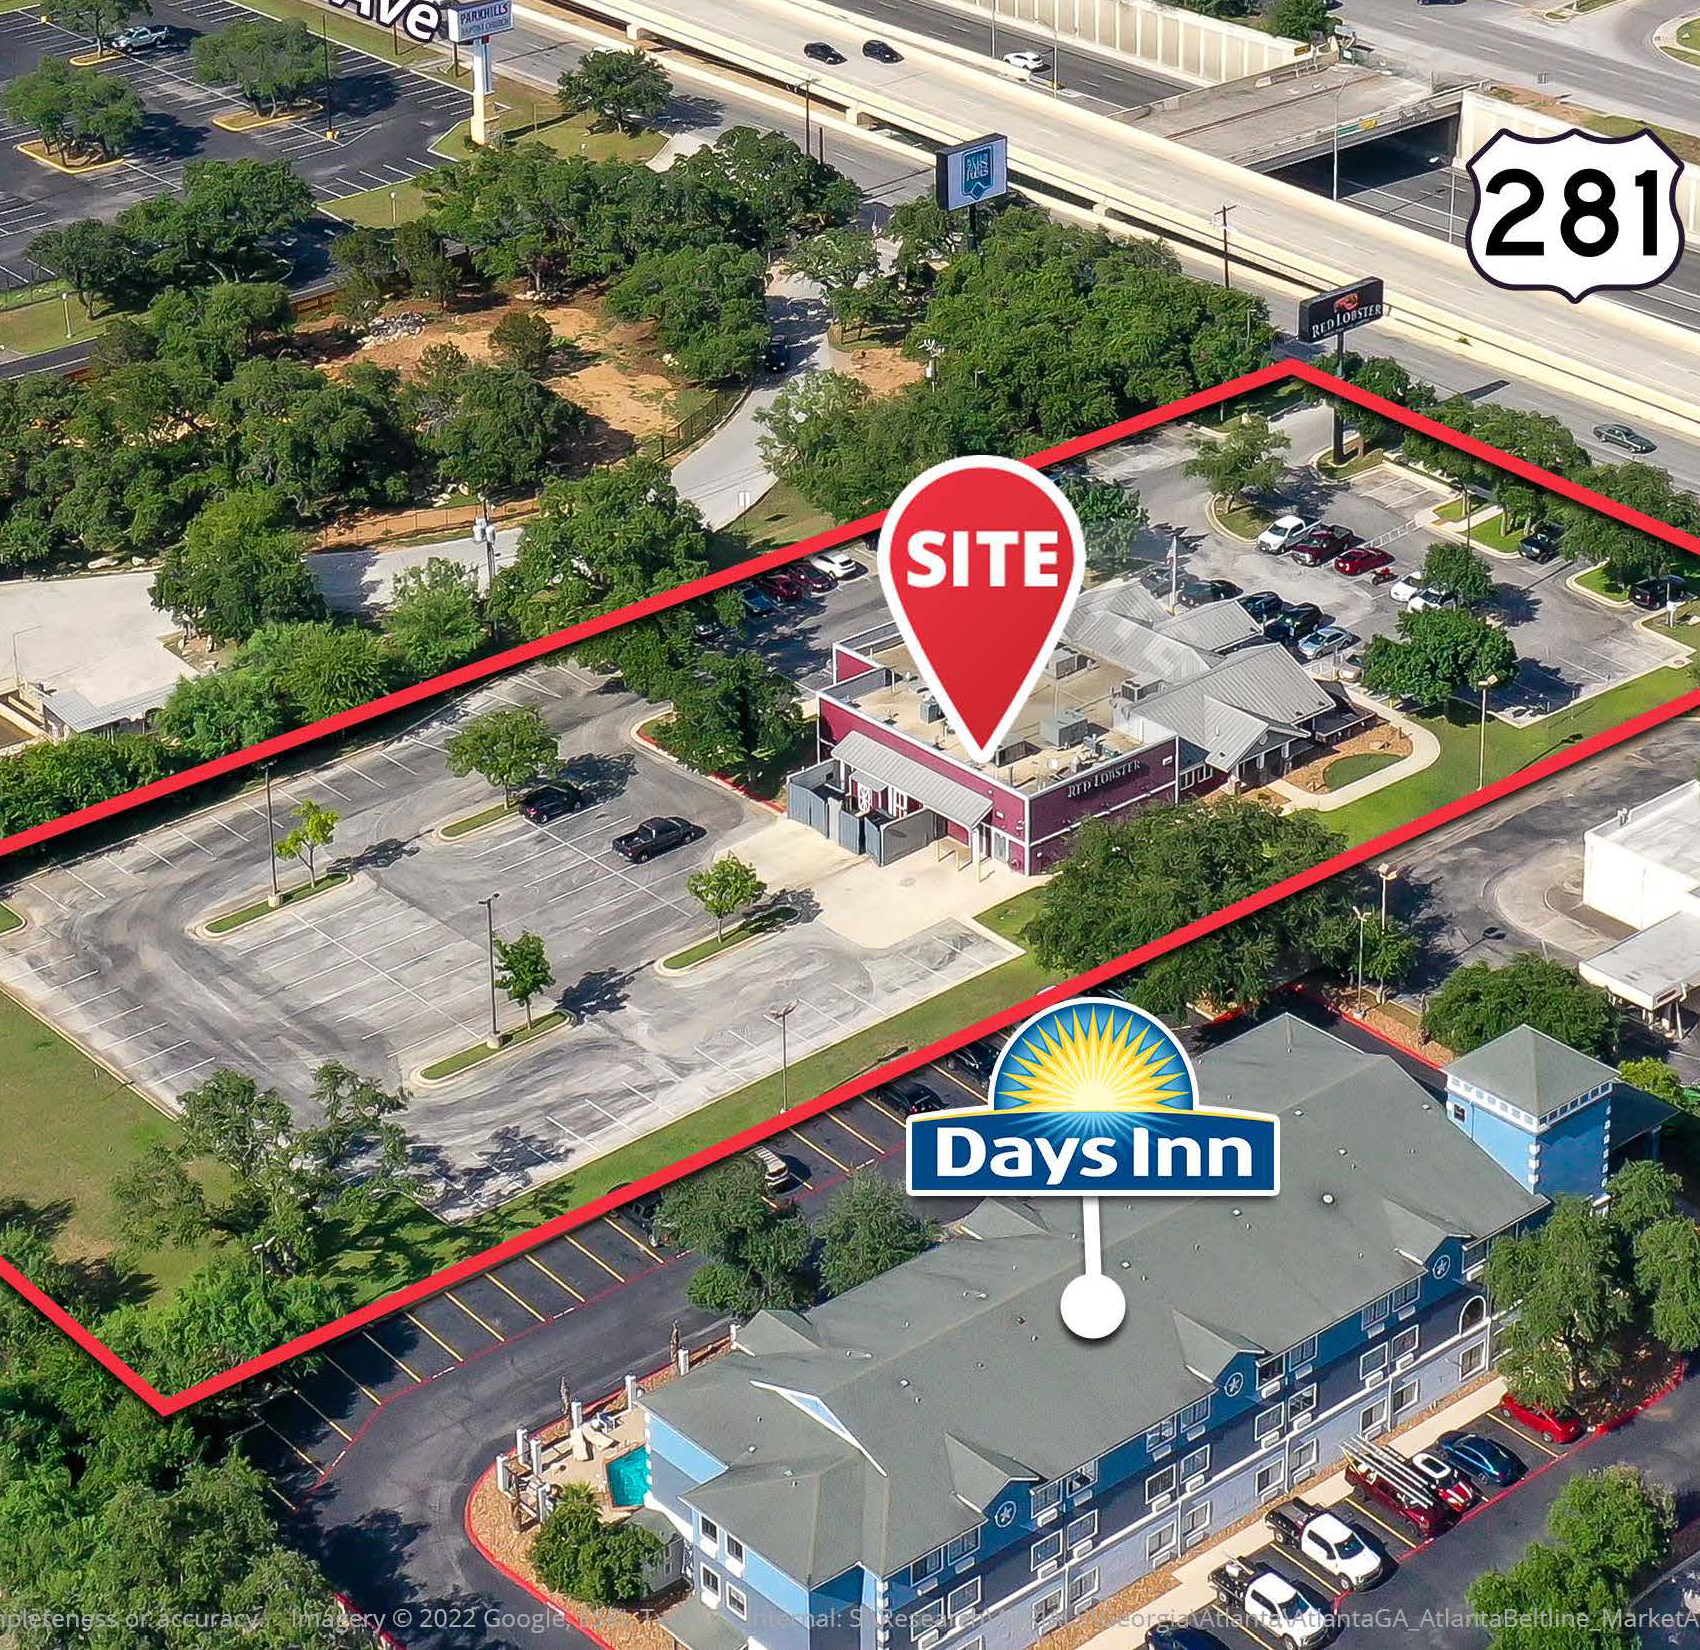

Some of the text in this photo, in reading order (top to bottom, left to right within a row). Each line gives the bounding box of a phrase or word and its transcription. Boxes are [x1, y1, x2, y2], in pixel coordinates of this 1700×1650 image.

[1312, 319, 1334, 339] RED
[1336, 304, 1382, 326] LOBSTER
[1094, 759, 1141, 787] LOBSTER
